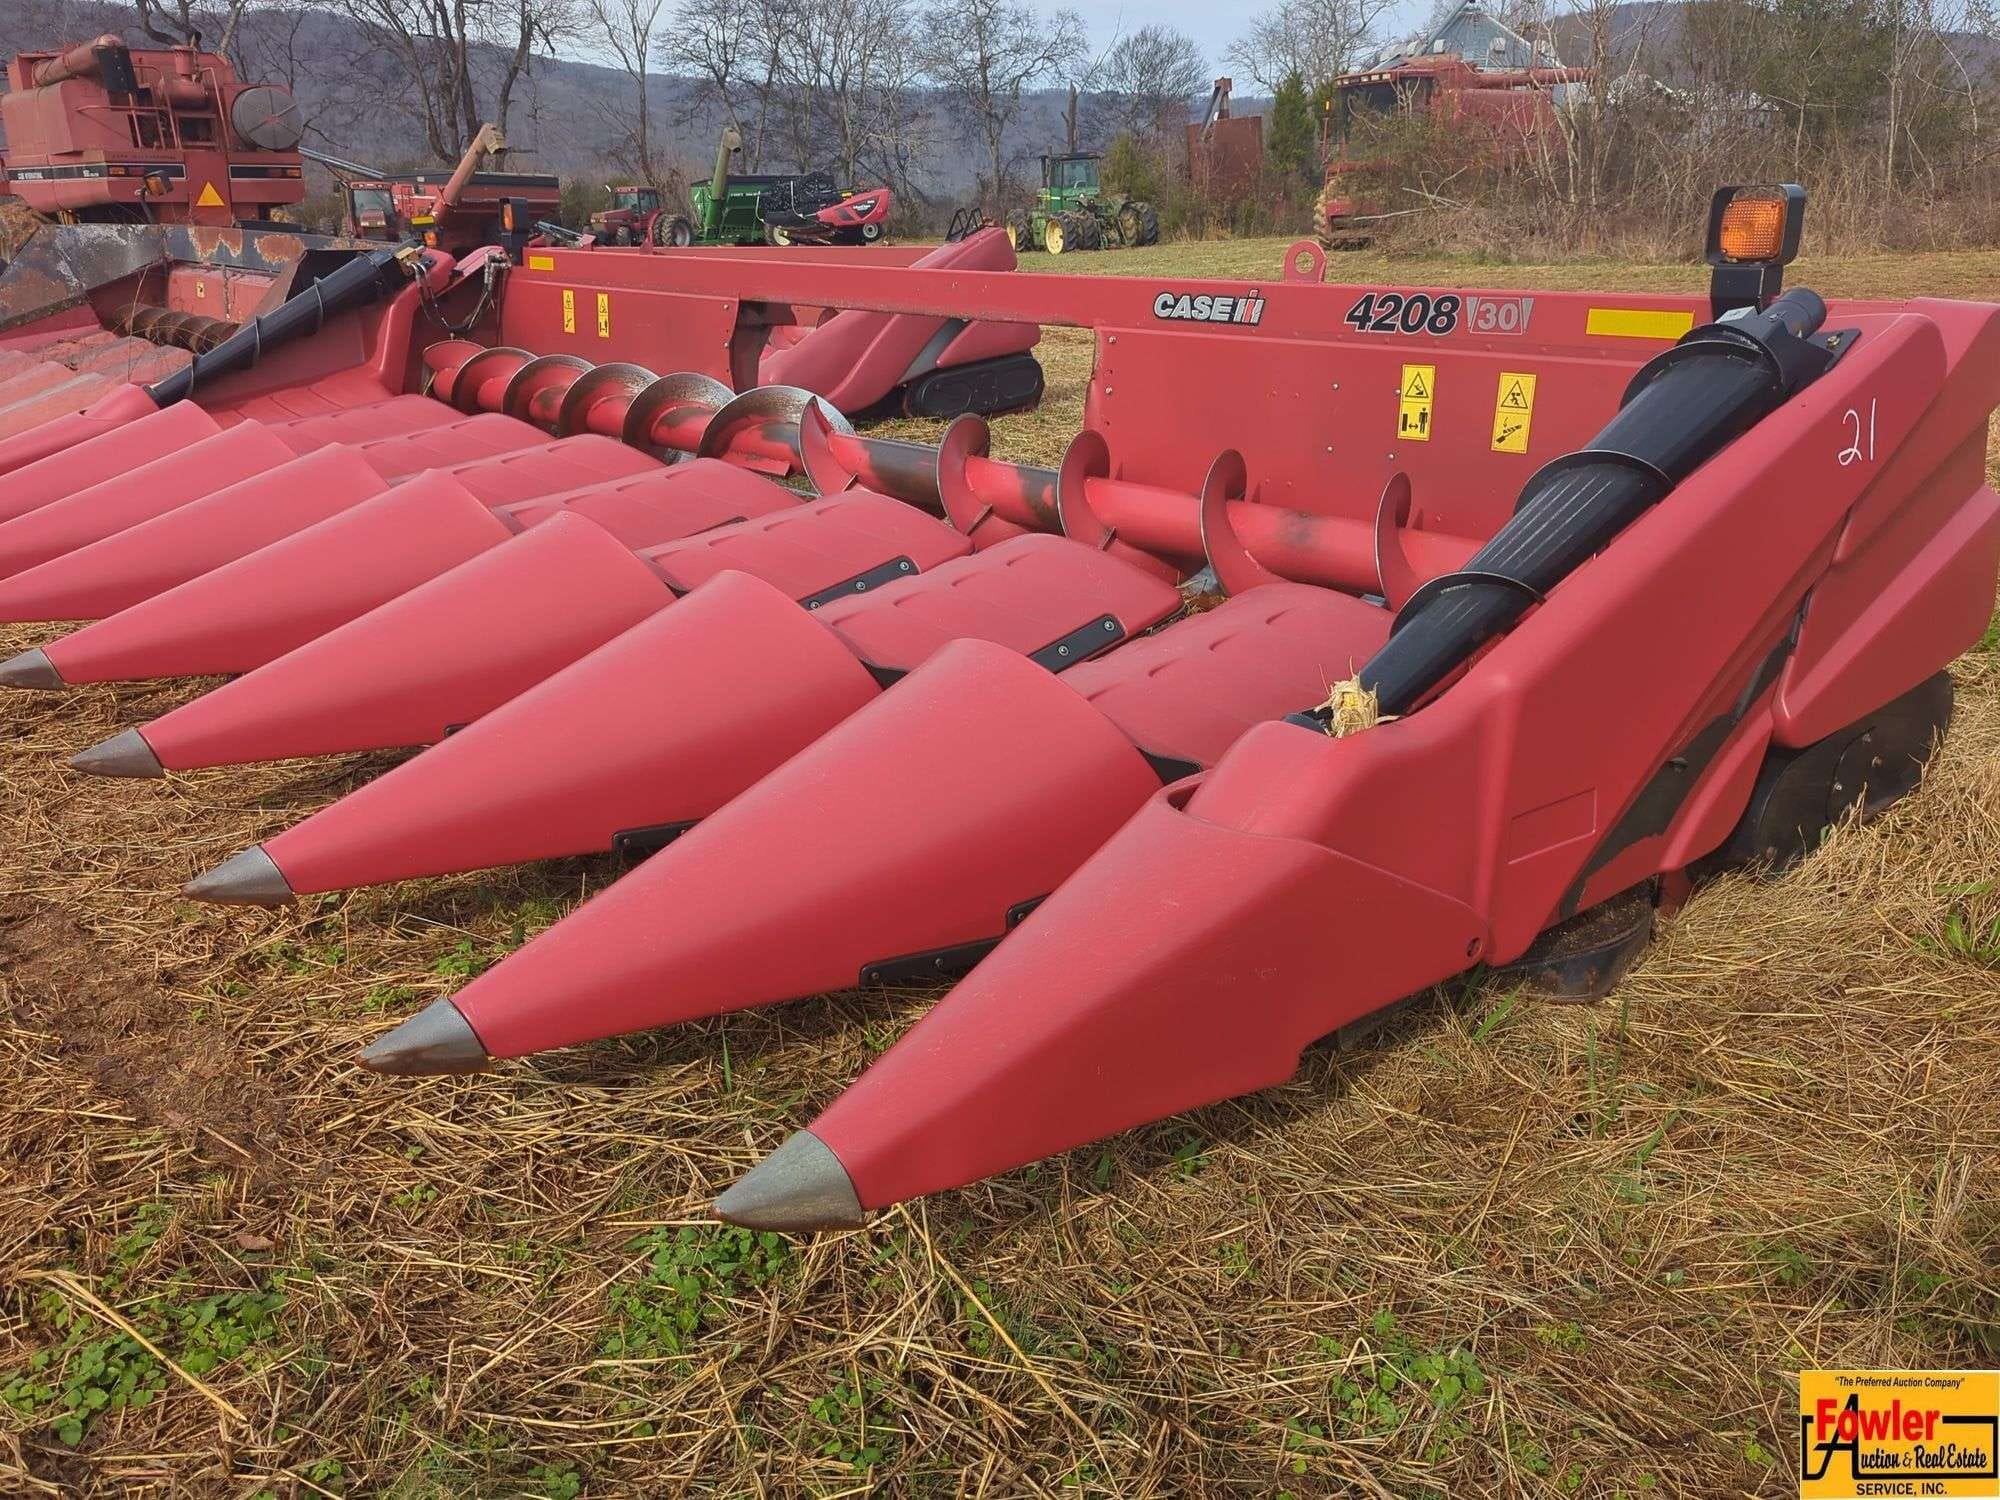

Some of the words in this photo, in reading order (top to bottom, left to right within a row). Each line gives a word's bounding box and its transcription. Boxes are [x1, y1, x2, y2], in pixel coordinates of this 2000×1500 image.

[1154, 292, 1234, 322] CASE
[1344, 292, 1461, 335] 4208
[1477, 302, 1519, 331] 30
[1838, 398, 1876, 466] 21
